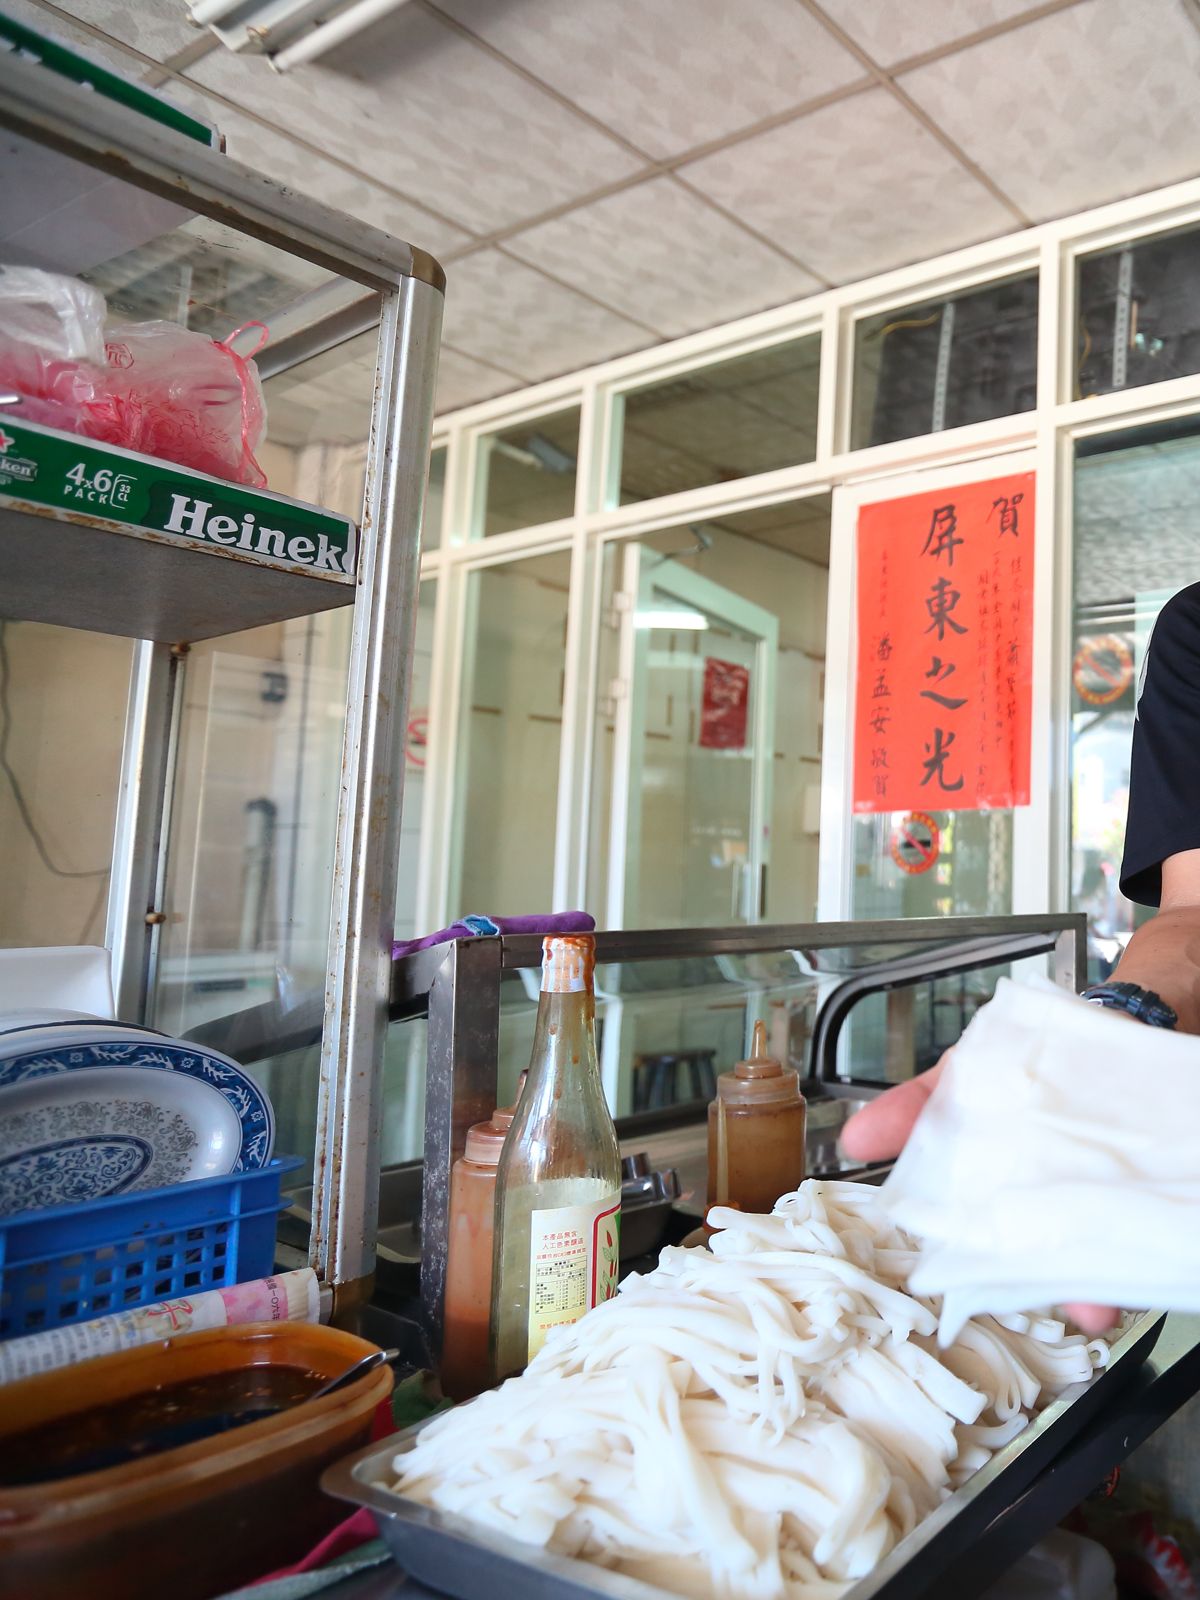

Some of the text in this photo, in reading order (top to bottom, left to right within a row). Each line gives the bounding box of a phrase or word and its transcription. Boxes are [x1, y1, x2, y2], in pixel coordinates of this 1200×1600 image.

[64, 485, 109, 505] PACK
[117, 492, 129, 502] CL
[119, 484, 131, 494] 33
[986, 492, 1025, 538] 賀
[919, 503, 969, 792] 屏東之光
